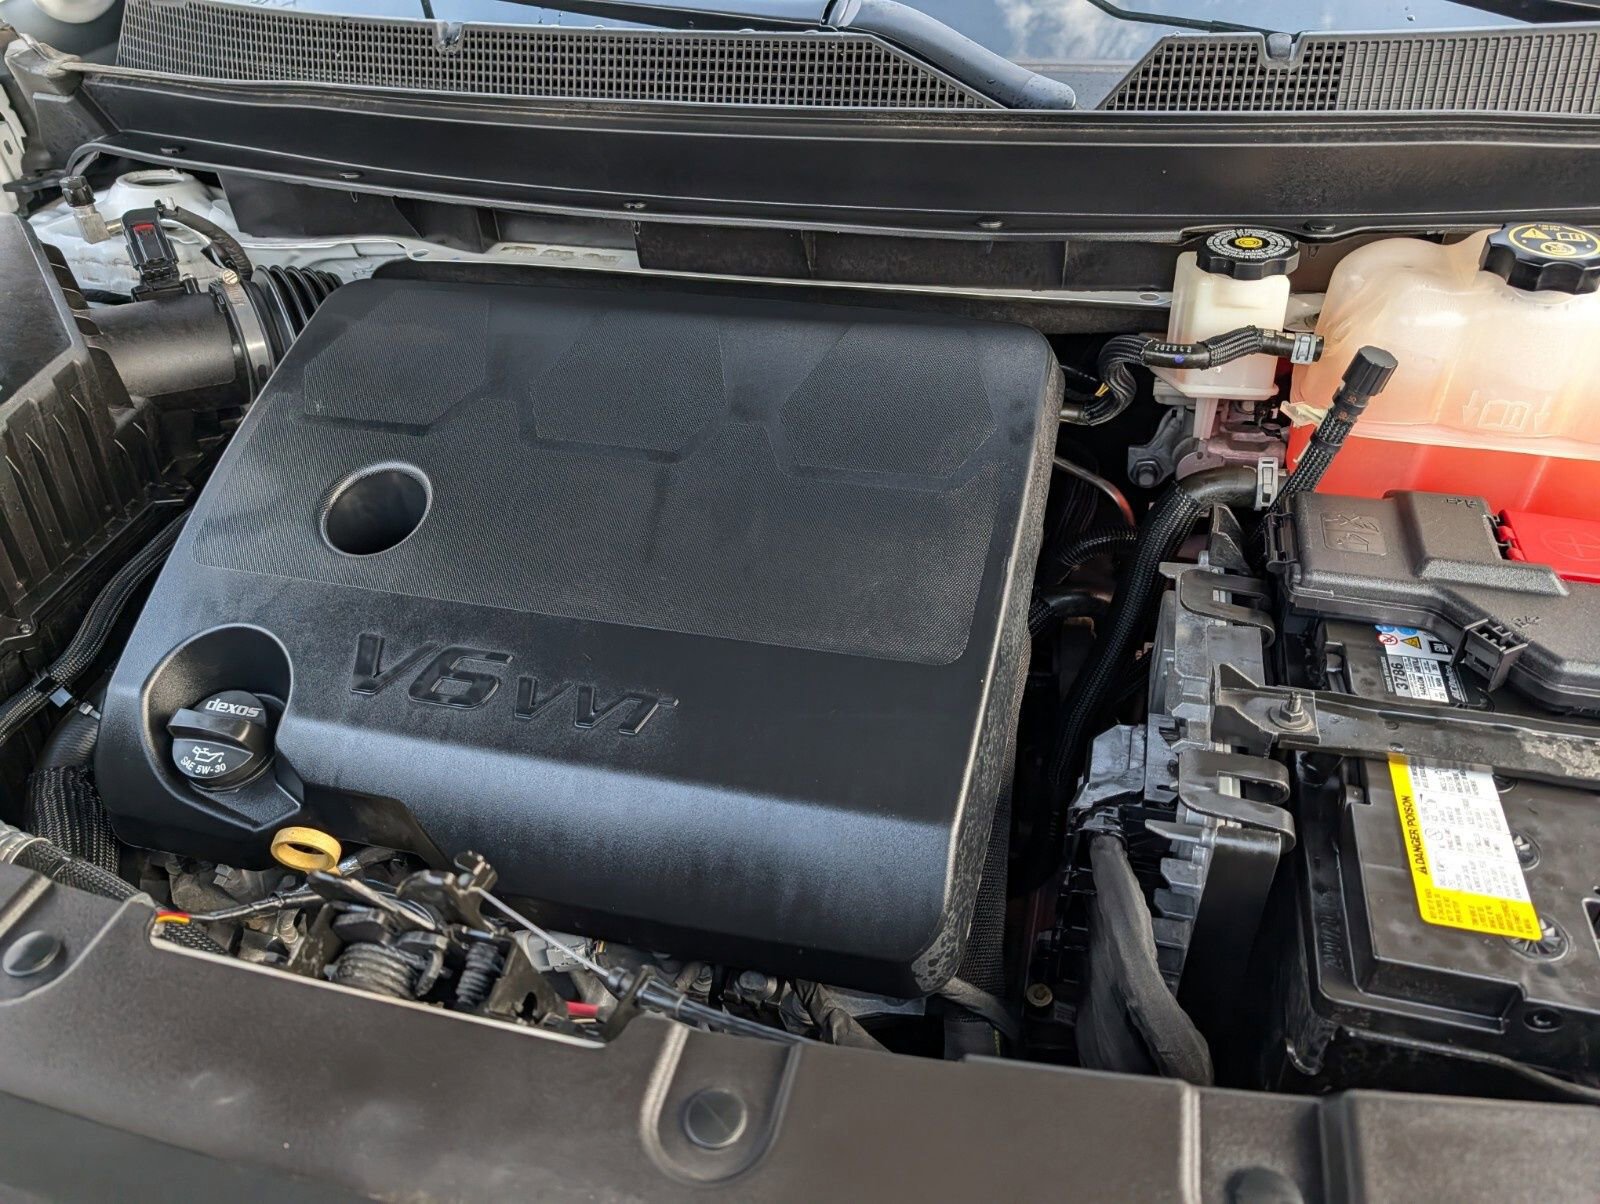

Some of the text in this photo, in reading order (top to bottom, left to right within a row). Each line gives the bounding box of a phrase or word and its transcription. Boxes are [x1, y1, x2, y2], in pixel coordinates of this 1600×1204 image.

[350, 633, 680, 735] V6 VVT
[1391, 662, 1409, 690] 3786
[205, 698, 264, 718] dexos
[180, 756, 227, 775] SAE 5W-30
